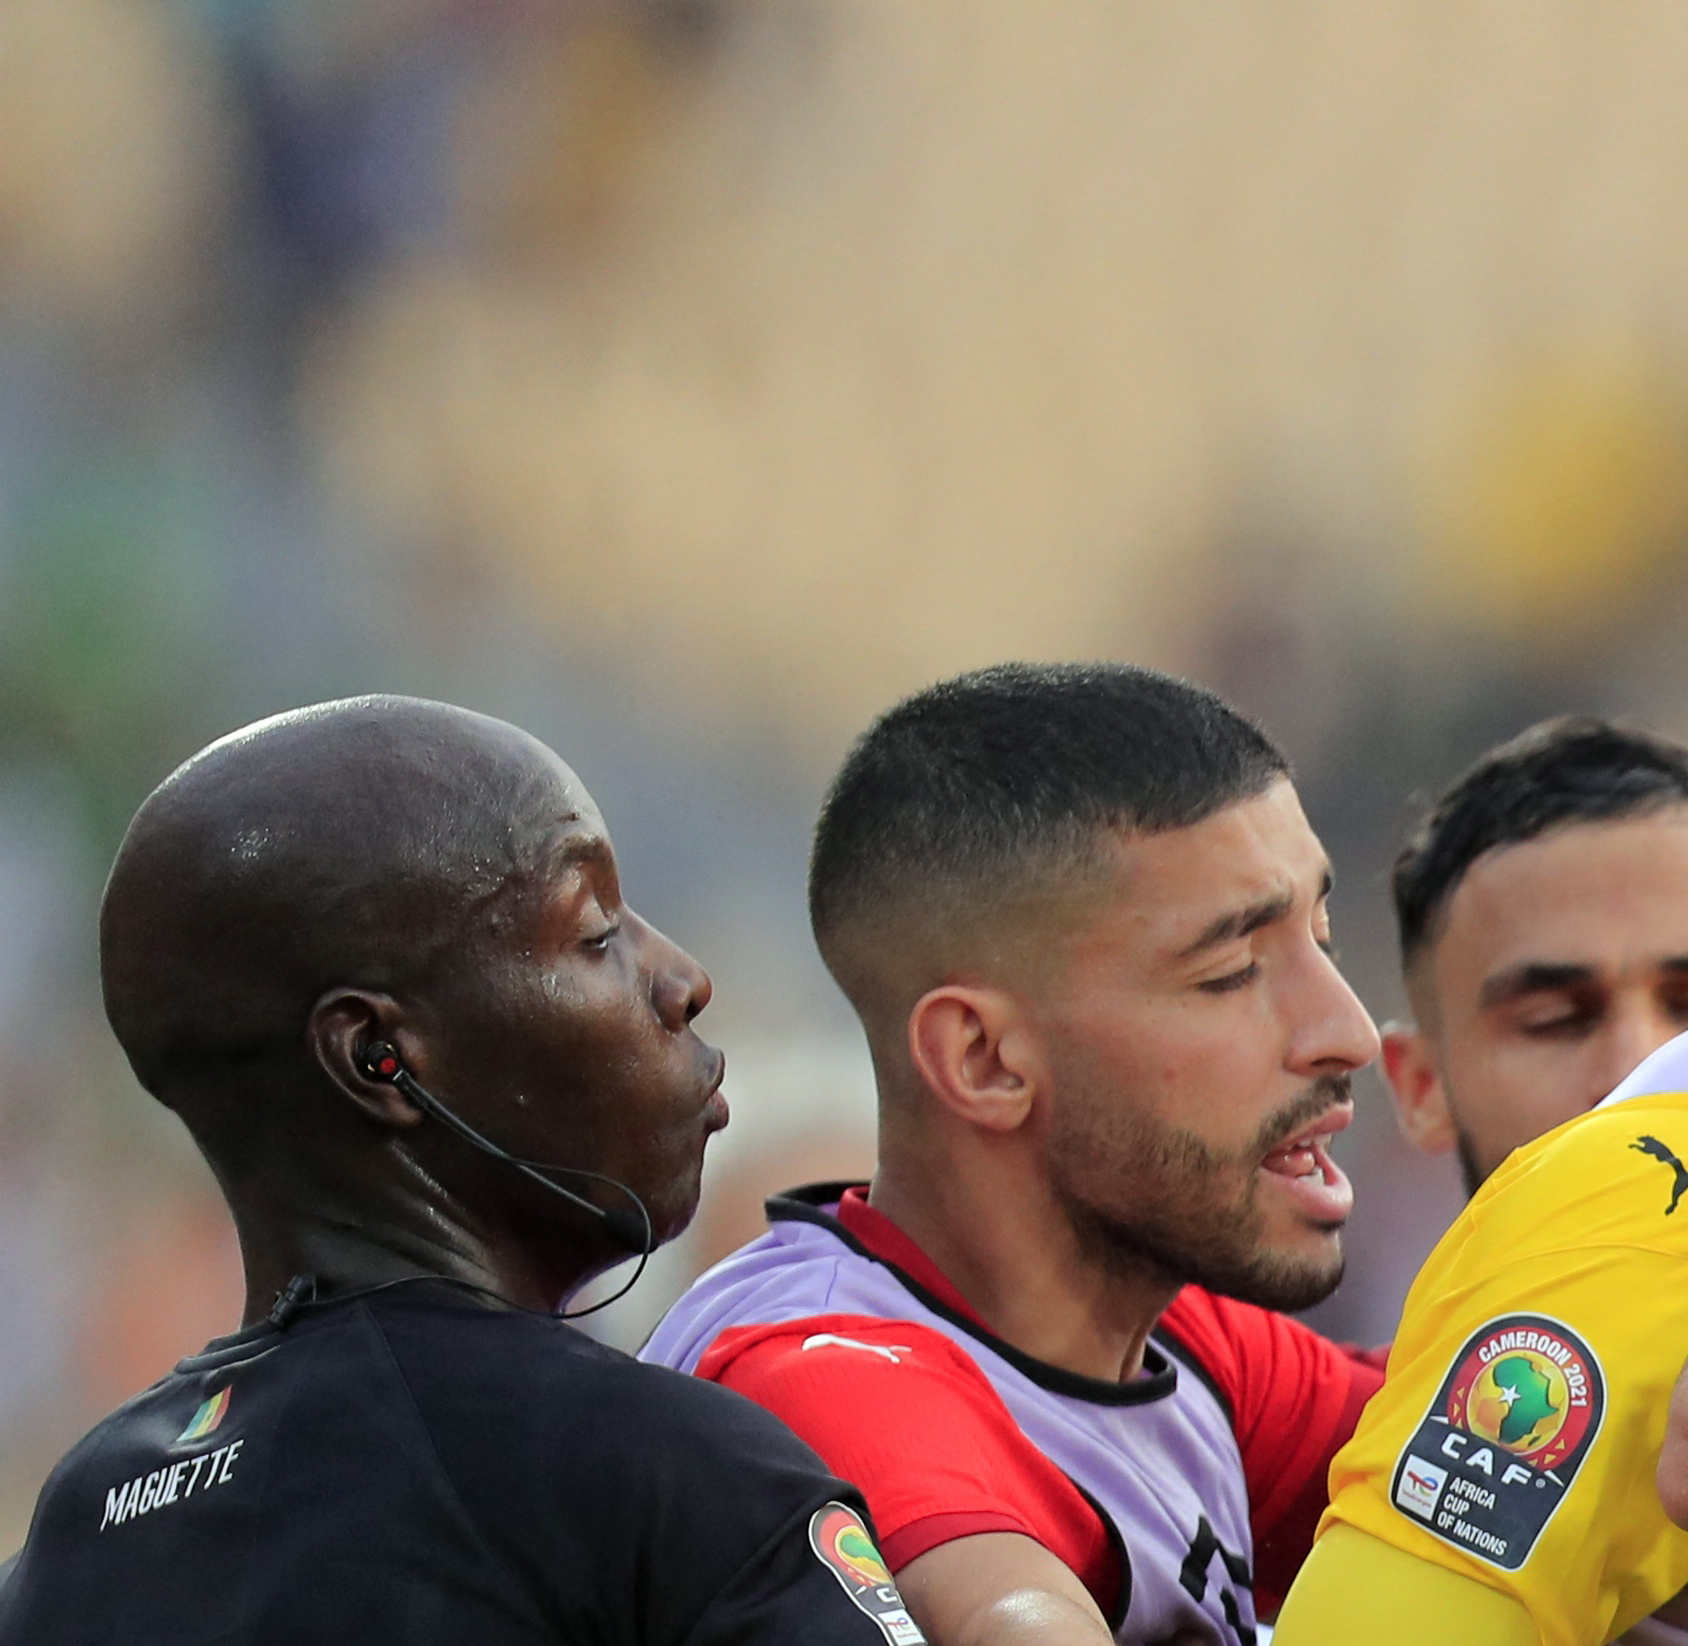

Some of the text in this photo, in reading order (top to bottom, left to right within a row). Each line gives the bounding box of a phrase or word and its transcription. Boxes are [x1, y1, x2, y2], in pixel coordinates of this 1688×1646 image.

[1478, 1330, 1588, 1407] CAMEROON 2021
[1441, 1432, 1532, 1485] CAF
[100, 1439, 244, 1532] MAGUETTE
[1444, 1494, 1470, 1515] CUP
[1449, 1476, 1496, 1510] AFRICA
[1437, 1511, 1507, 1556] OF NATIONS
